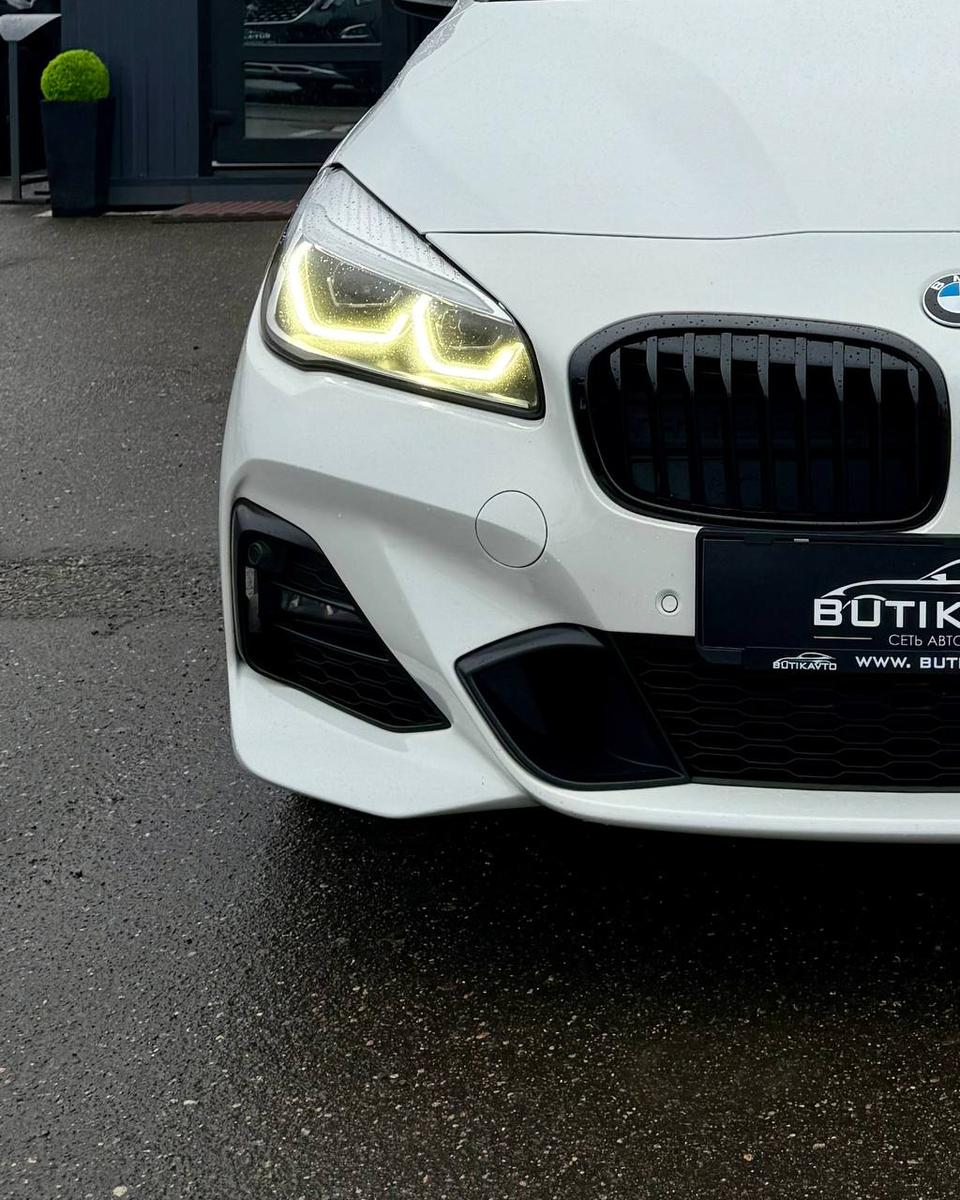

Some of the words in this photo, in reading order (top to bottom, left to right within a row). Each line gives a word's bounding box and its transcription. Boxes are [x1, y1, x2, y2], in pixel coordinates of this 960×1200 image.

[888, 633, 923, 647] СЕТЬ
[772, 661, 837, 671] BUTIKAVTO
[855, 655, 911, 668] WWW.
